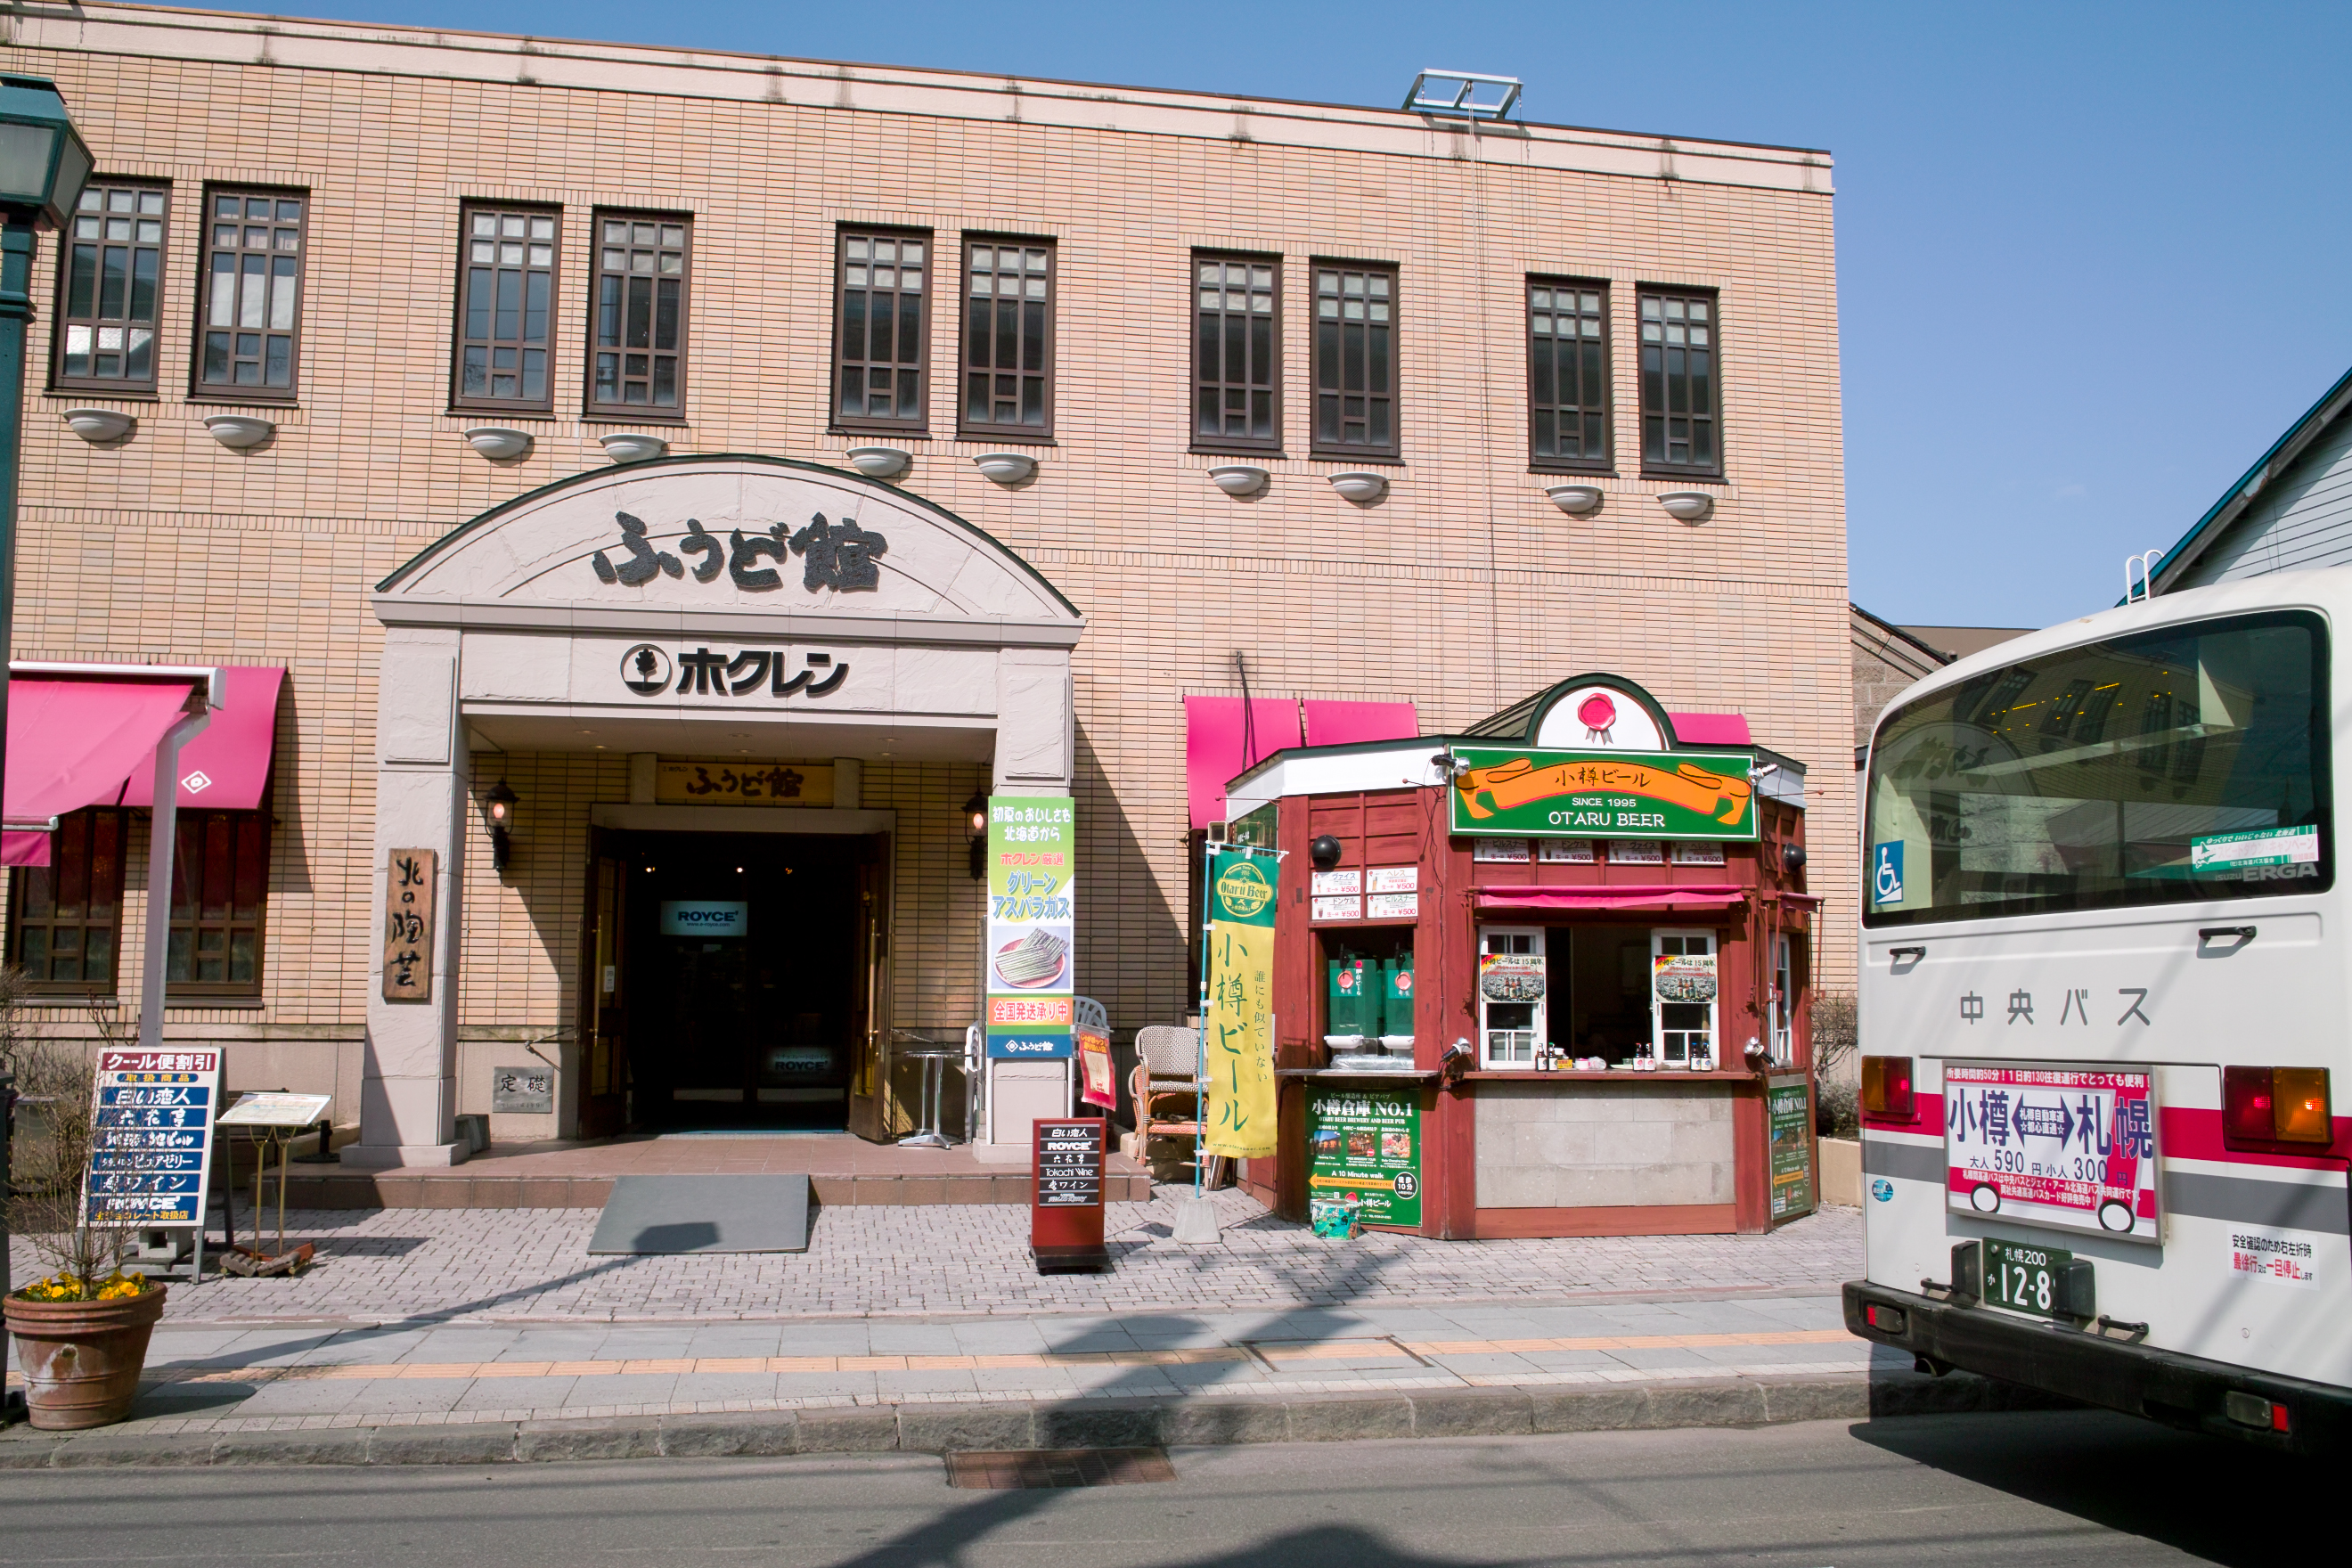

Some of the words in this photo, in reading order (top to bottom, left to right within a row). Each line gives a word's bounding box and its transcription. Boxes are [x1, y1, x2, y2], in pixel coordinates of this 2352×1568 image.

[592, 510, 887, 589] ふうど館
[676, 648, 848, 695] ホクレン
[686, 766, 804, 797] ふうど館
[1556, 766, 1651, 788] 小樽ビール
[1572, 797, 1603, 806] SINCE
[1607, 798, 1637, 807] 1995
[992, 805, 1071, 823] 初夏のおいしさを
[1548, 812, 1611, 826] OTARU
[1617, 813, 1665, 827] BEER
[1004, 826, 1060, 842] 北海道から
[2207, 835, 2234, 845] ゆっくりで
[2274, 829, 2296, 837] 北海道
[1000, 853, 1041, 865] ホクレン
[1041, 853, 1064, 865] 厳選
[2216, 873, 2242, 881] ISUZU
[2243, 862, 2319, 882] ERGA
[1007, 870, 1058, 894] グリーン
[1221, 881, 1245, 895] Otaru
[1247, 885, 1268, 899] Beer
[992, 895, 1071, 919] アスパラガス
[390, 856, 424, 986] 北の陶芸
[678, 911, 739, 922] ROYCE'
[994, 1000, 1067, 1022] 全国発送承り中
[1960, 987, 2151, 1025] 中央バス
[1217, 933, 1249, 1131] 小樽ビール
[1254, 970, 1267, 1082] 誰にも似ていない
[1018, 1041, 1054, 1051] ふうど館
[108, 1054, 211, 1070] クール便割引
[126, 1074, 190, 1082] 取扱商品
[500, 1074, 546, 1093] 定礎
[116, 1088, 191, 1105] 白い恋人
[1311, 1099, 1371, 1116] 小樽倉庫
[1375, 1102, 1413, 1116] NO.1
[2020, 1107, 2064, 1123] 札樽自動車道
[119, 1107, 186, 1128] 六花亭
[1948, 1088, 2010, 1147] 小樽
[2076, 1095, 2152, 1159] 札幌
[1052, 1128, 1088, 1137] 白い恋人
[1048, 1141, 1091, 1150] ROYCE'
[1053, 1154, 1084, 1164] 六花亭
[1969, 1156, 1989, 1170] 大人
[1994, 1149, 2024, 1173] 590
[2031, 1162, 2042, 1175] 円
[2046, 1164, 2069, 1179] 小人
[2074, 1157, 2108, 1183] 300
[2117, 1172, 2127, 1186] 円
[1046, 1168, 1074, 1176] Tokachi
[1075, 1168, 1093, 1176] Wine
[1360, 1198, 1392, 1207] 小樽ビール
[2232, 1234, 2312, 1259] 安全確認のため右左折時
[2002, 1263, 2055, 1310] 12-8
